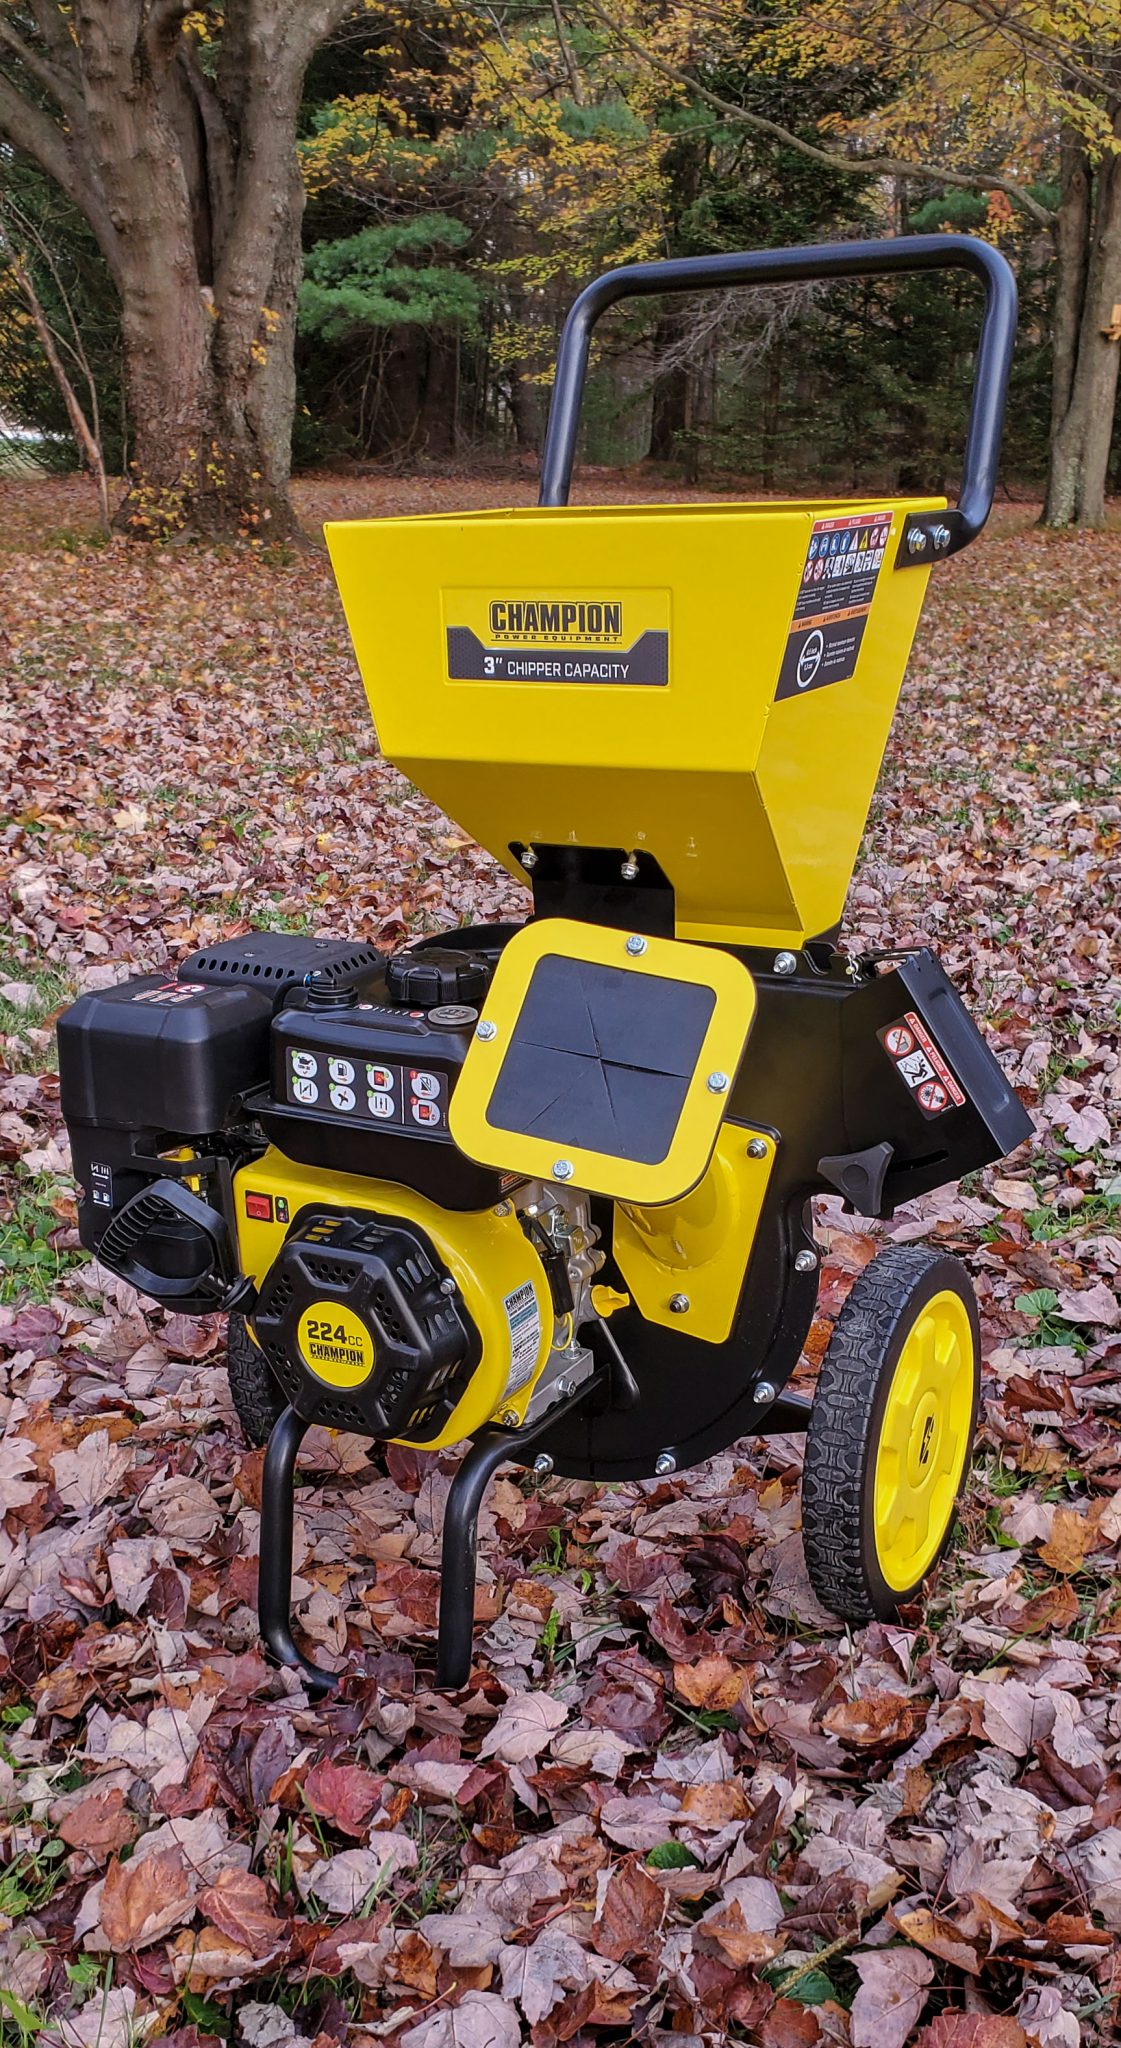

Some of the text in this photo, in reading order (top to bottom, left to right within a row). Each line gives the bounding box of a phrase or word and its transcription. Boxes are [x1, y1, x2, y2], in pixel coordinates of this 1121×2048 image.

[491, 602, 621, 635] CHAMPION
[484, 656, 630, 679] 3" CHIPPER CAPACITY
[309, 1343, 364, 1363] CHAMPION
